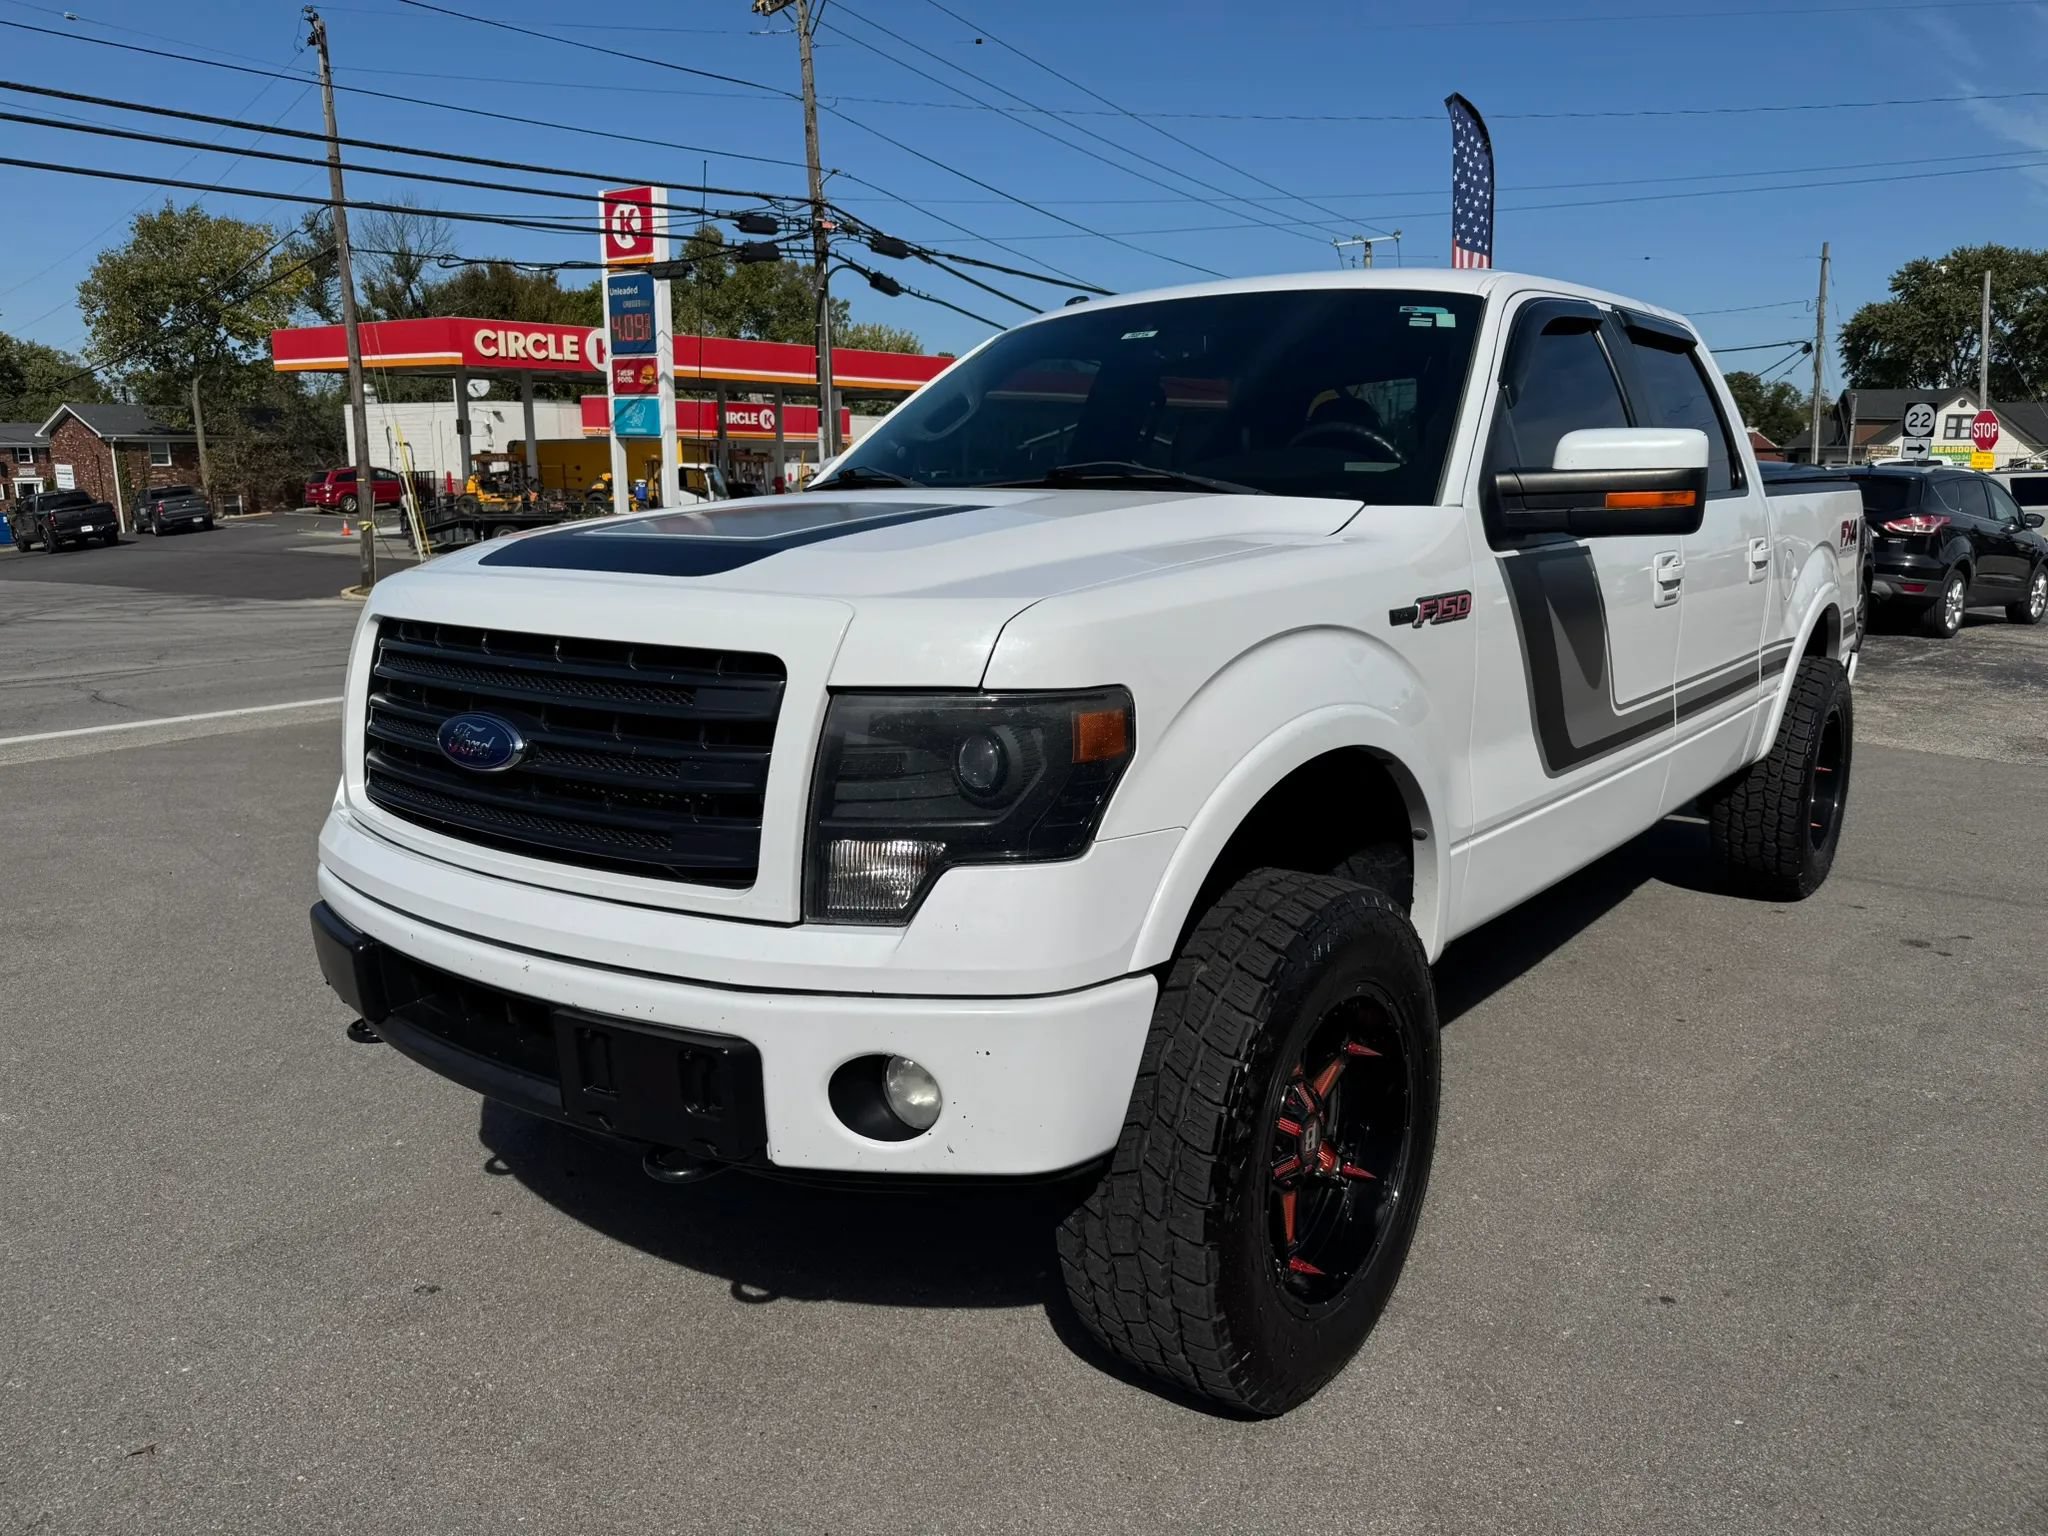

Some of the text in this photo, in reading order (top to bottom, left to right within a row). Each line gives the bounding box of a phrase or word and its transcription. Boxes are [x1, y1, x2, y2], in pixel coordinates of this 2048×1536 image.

[609, 286, 639, 296] Unleaded
[474, 328, 580, 361] CIRCLE
[724, 411, 758, 425] IRCLE
[1908, 412, 1931, 428] 22
[1973, 422, 1998, 438] STOP
[1841, 518, 1858, 547] FX4
[450, 721, 497, 757] Ford
